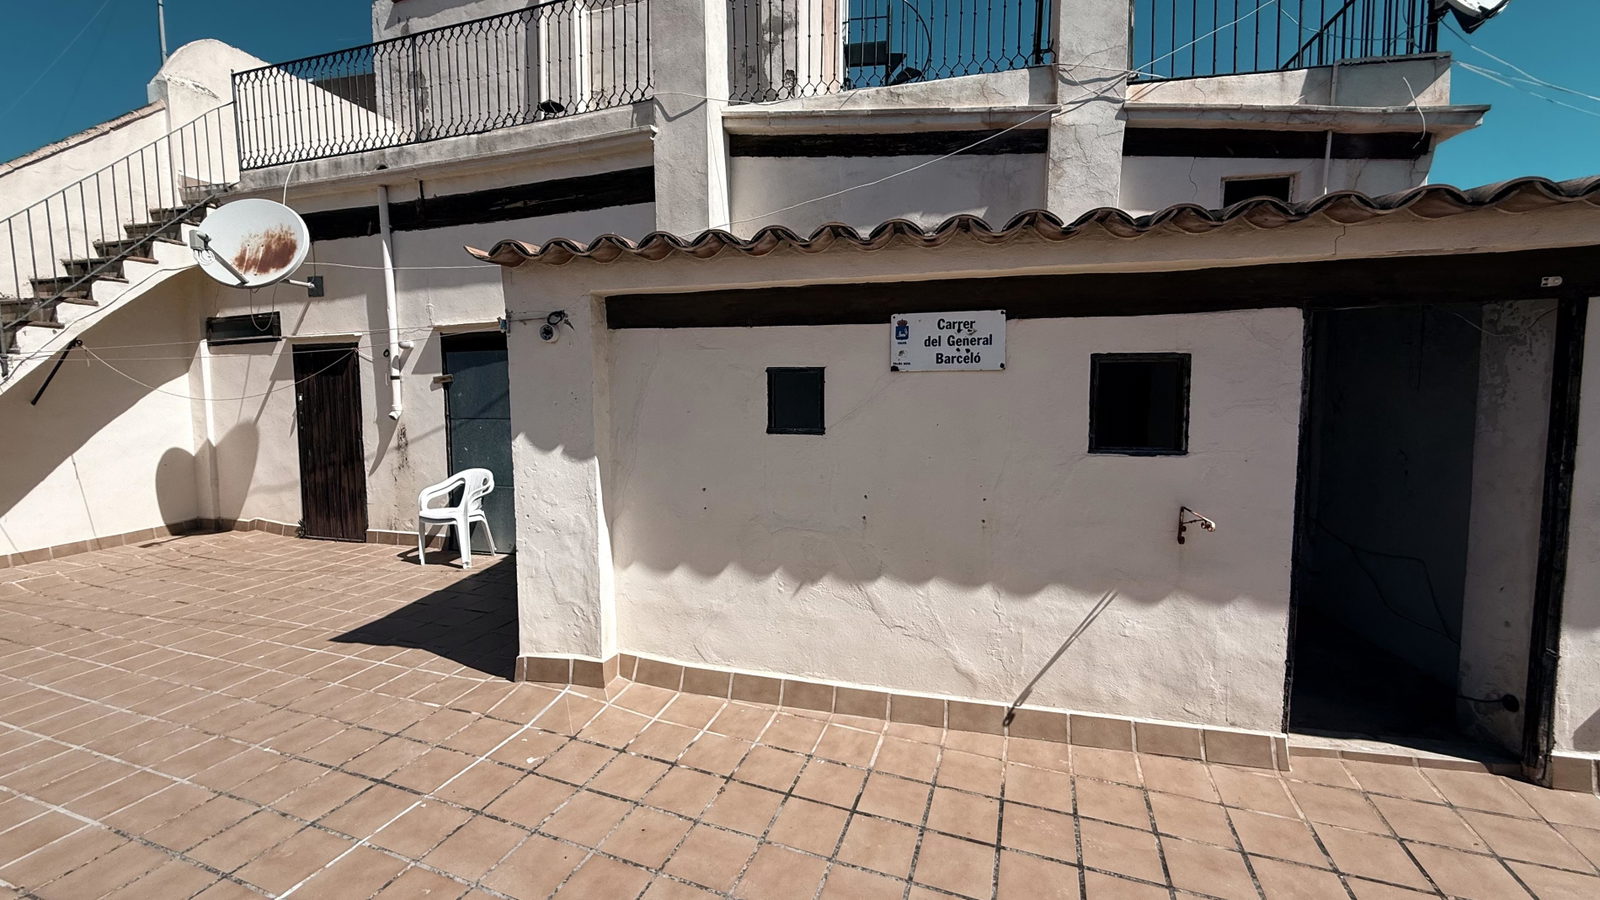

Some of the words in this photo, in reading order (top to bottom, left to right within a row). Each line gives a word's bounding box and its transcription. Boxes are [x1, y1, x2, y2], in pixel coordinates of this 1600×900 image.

[937, 318, 976, 330] Carrer
[924, 335, 942, 347] del
[947, 334, 992, 347] General
[935, 352, 981, 364] Barceló
